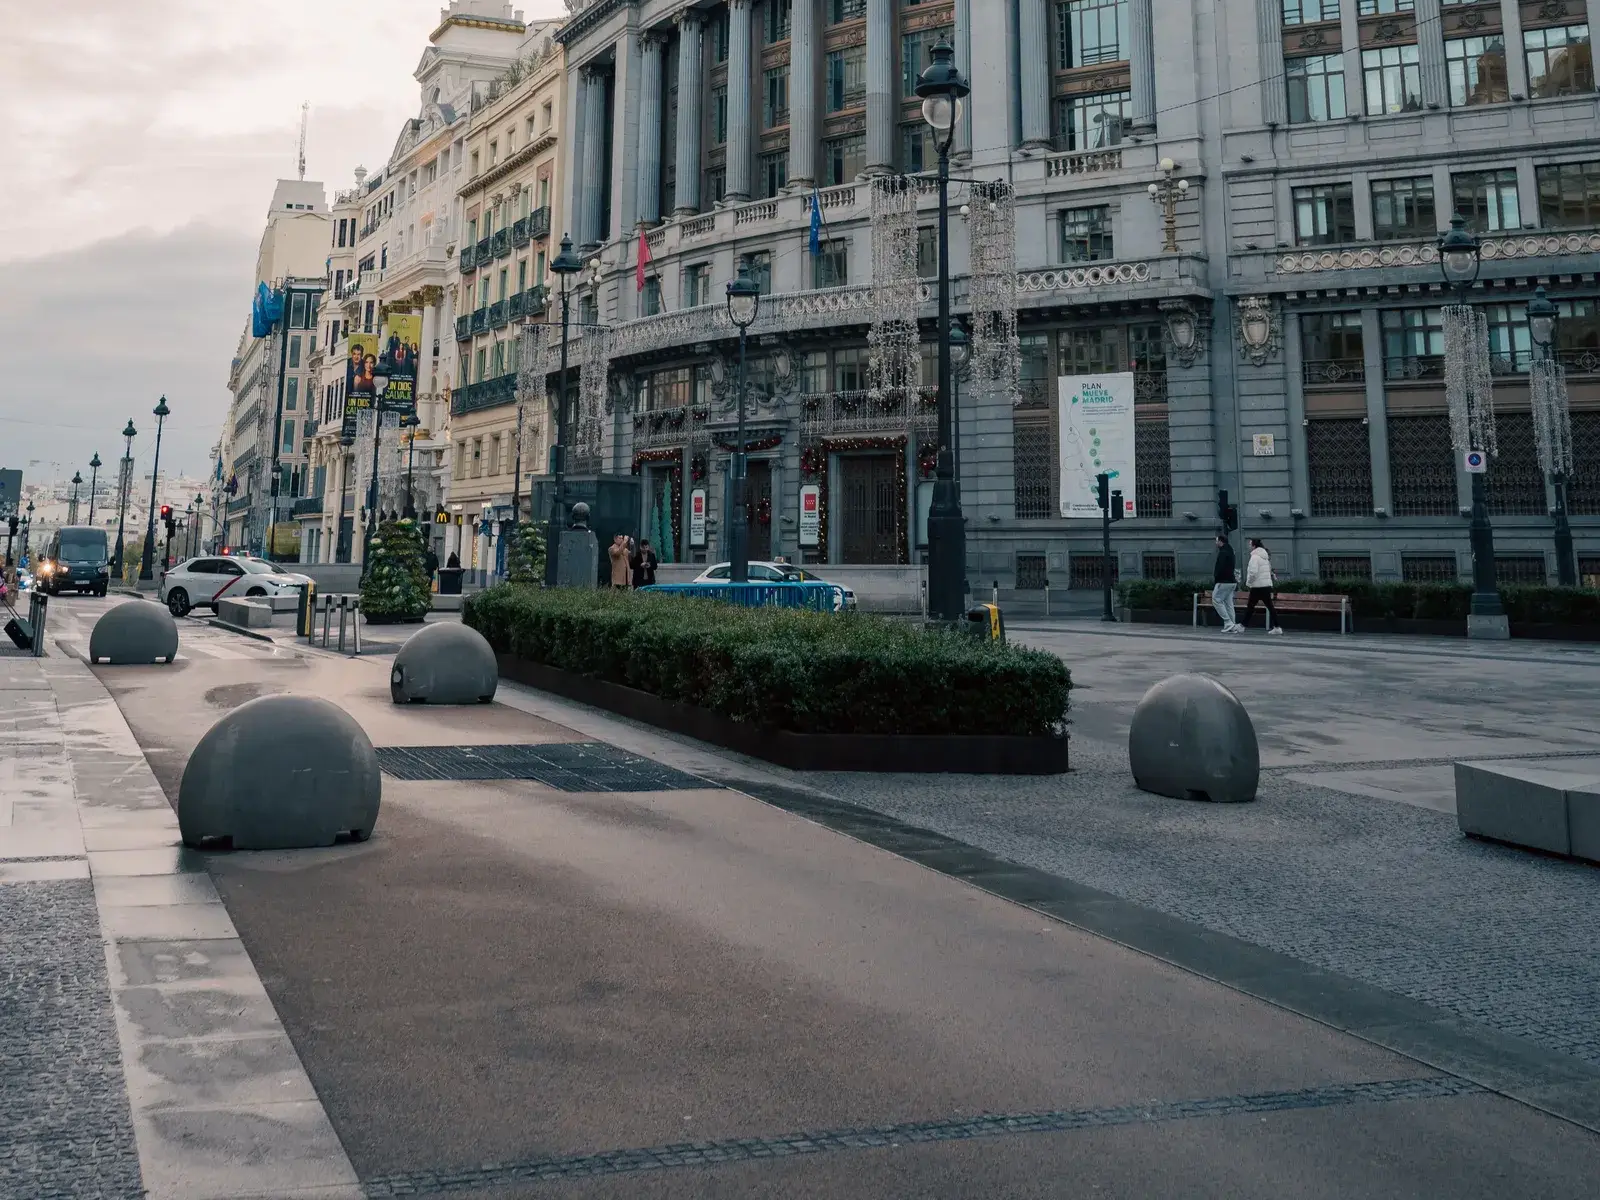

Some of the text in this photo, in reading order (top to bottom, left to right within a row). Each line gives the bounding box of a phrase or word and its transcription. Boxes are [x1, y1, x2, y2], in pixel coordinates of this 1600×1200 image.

[397, 381, 412, 391] DIOS
[385, 390, 413, 400] SALVAJE
[348, 398, 370, 407] UN DIOS
